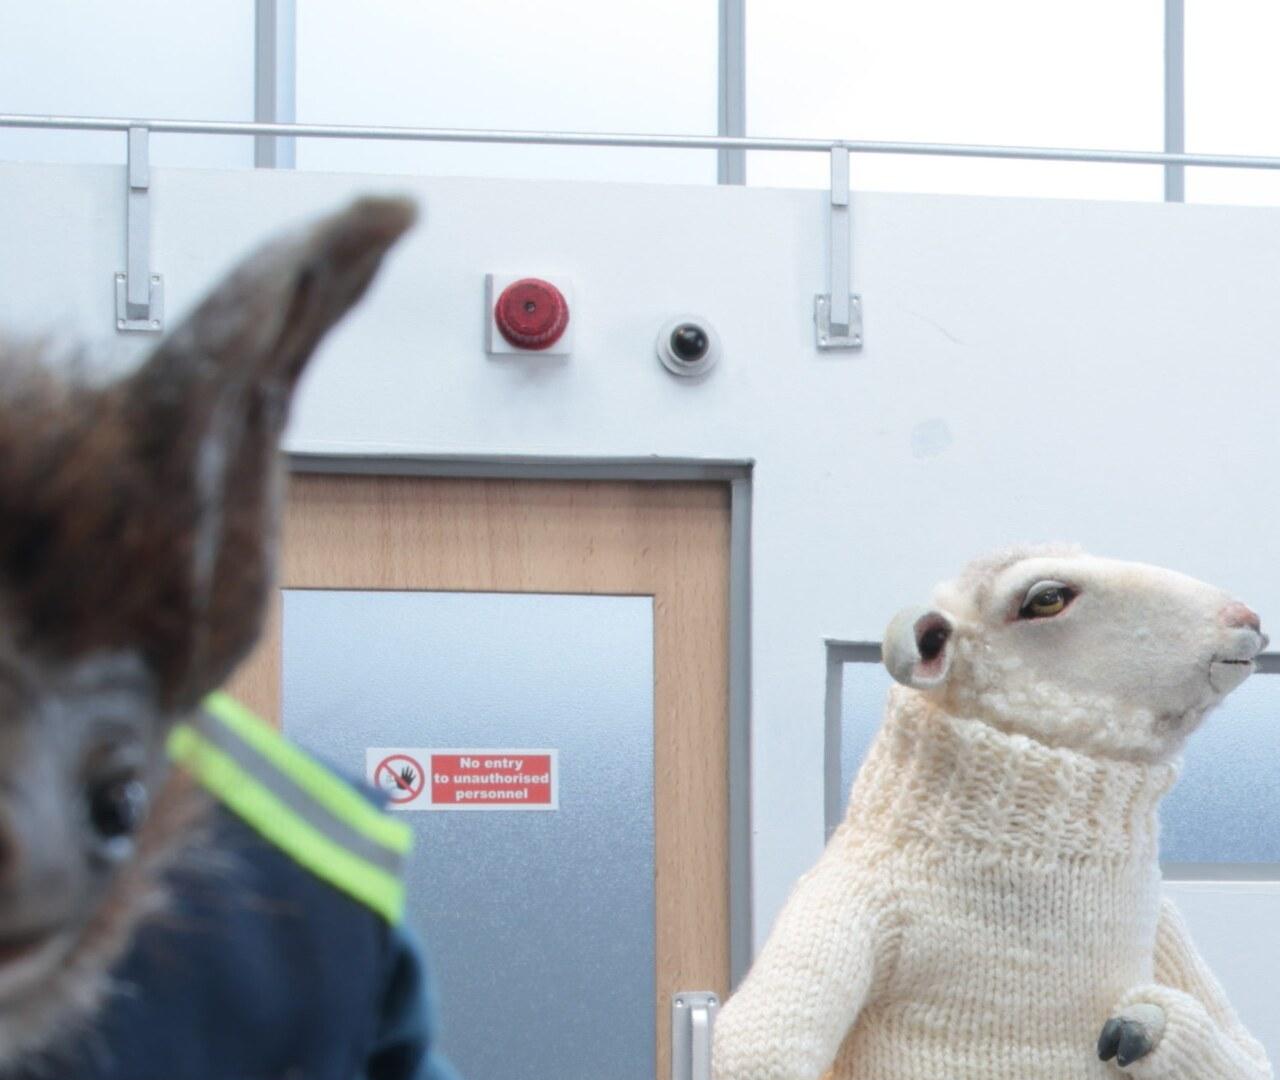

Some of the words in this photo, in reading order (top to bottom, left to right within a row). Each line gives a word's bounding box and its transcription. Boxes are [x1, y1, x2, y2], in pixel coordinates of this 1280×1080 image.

[460, 758, 480, 768] No
[484, 758, 523, 770] entry
[434, 774, 448, 784] to
[454, 773, 549, 784] unauthorised
[456, 788, 528, 801] personnel
